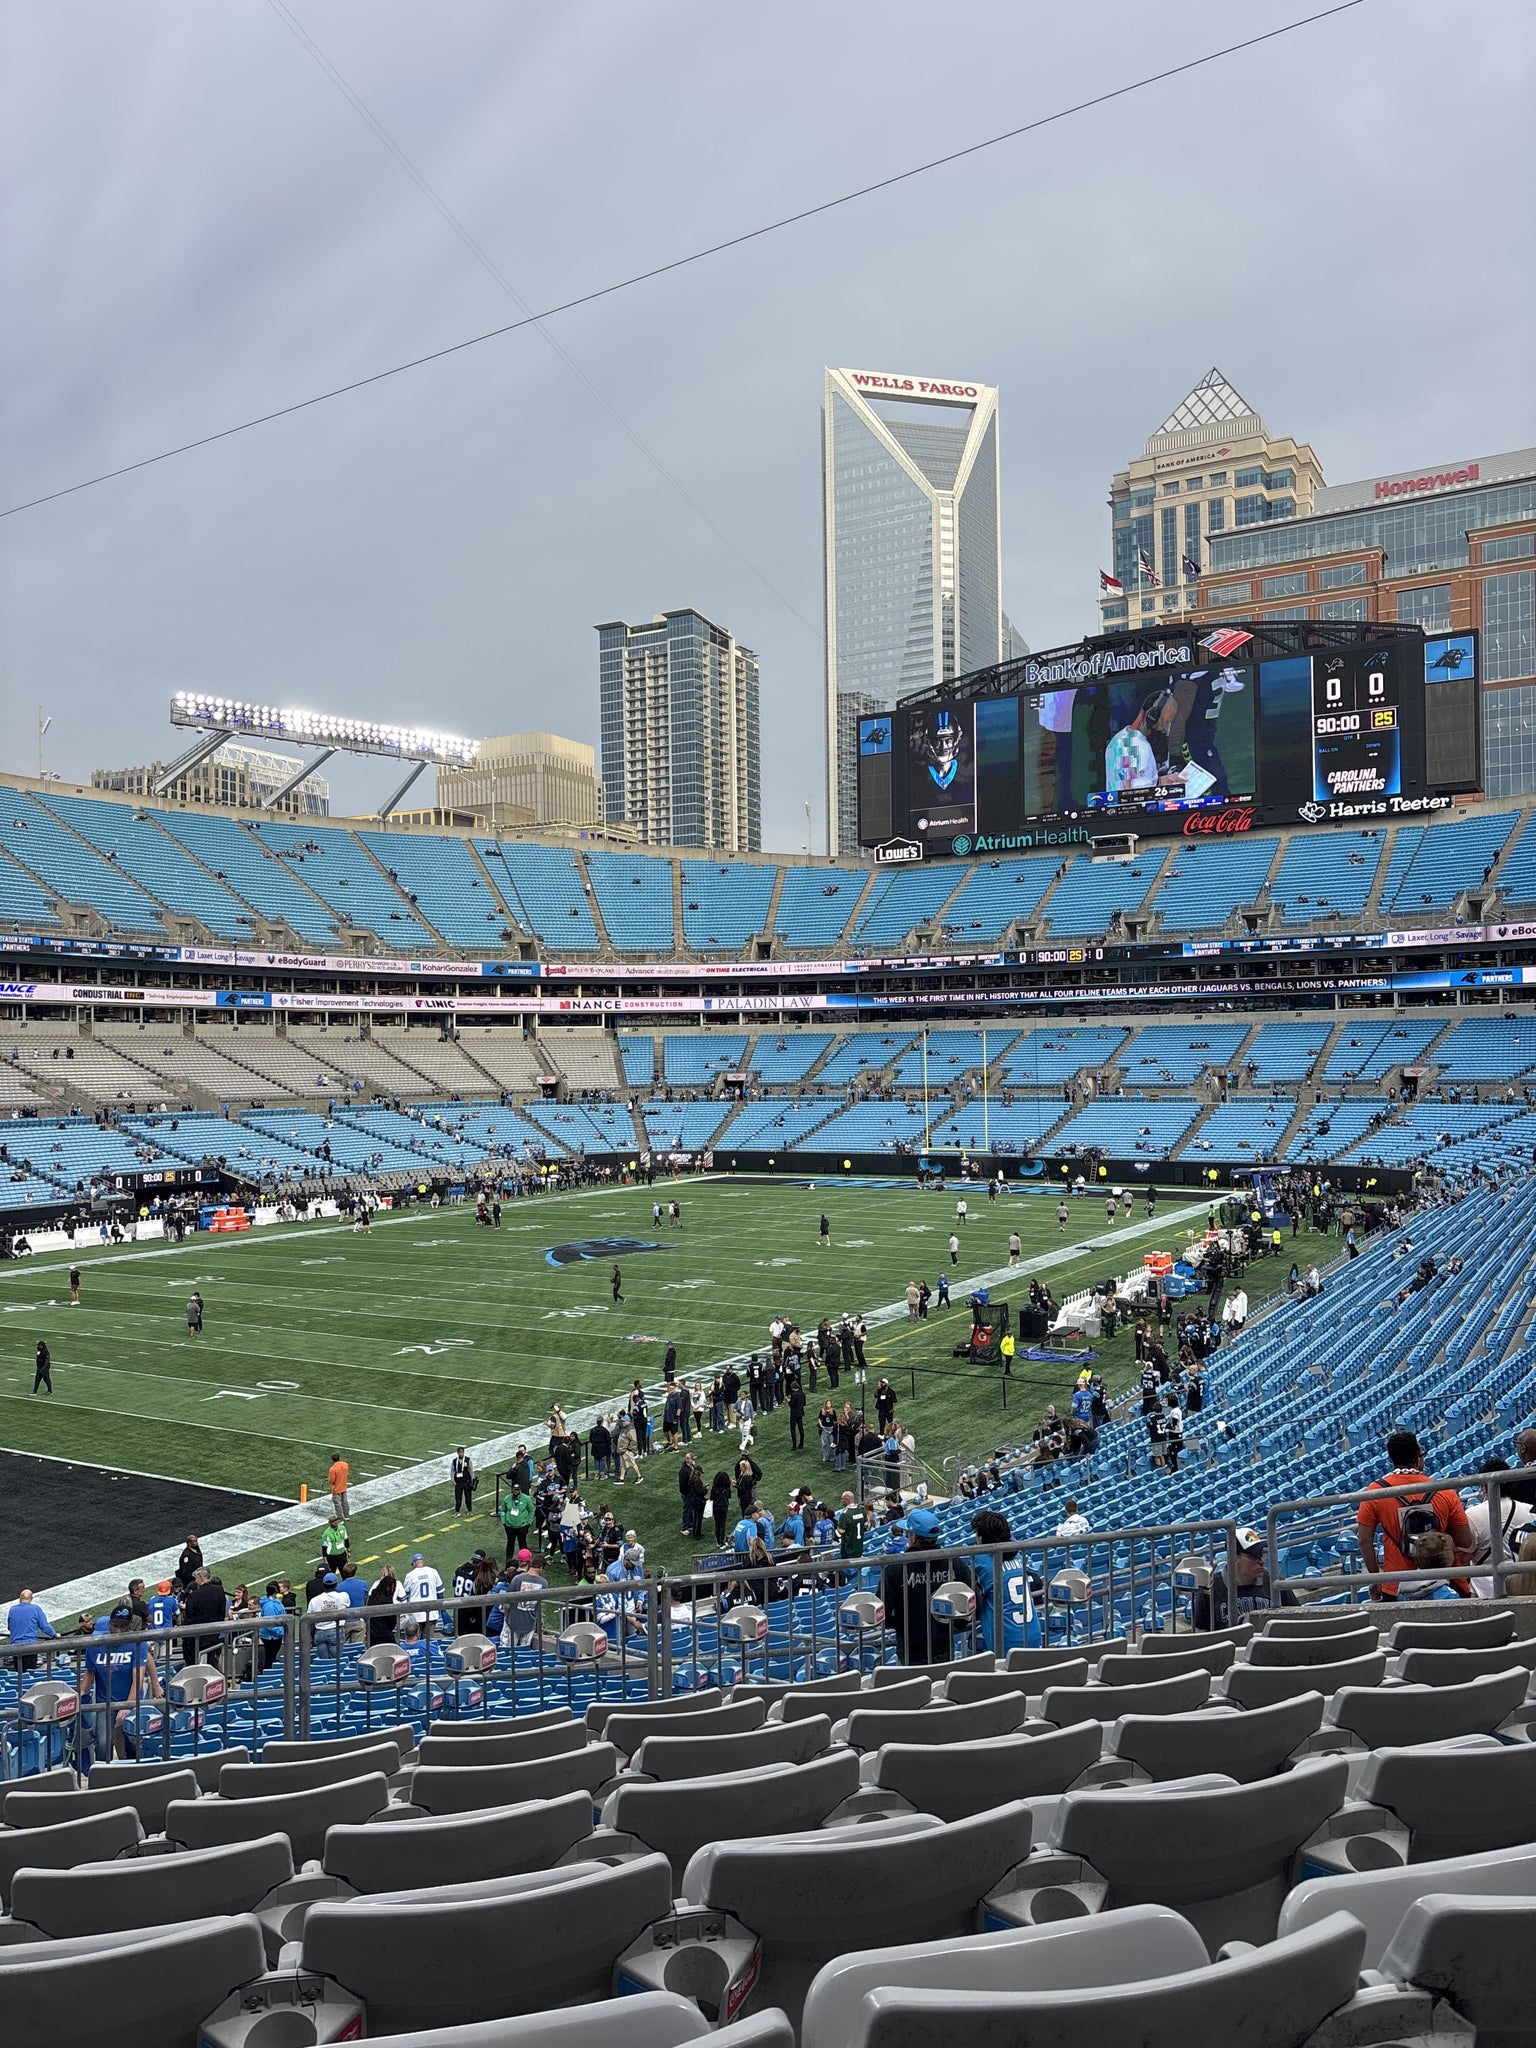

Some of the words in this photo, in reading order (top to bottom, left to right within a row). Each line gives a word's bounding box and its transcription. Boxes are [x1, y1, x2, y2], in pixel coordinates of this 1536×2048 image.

[852, 374, 914, 391] WELLS
[918, 381, 978, 398] FARGO
[1157, 461, 1175, 470] BANK
[1185, 453, 1216, 464] AMERICA
[1374, 463, 1480, 498] Honeywell
[1025, 657, 1077, 685] Bank
[1077, 653, 1101, 676] of
[1101, 644, 1191, 674] America
[1326, 678, 1341, 700] 0
[1369, 672, 1384, 695] 0
[1316, 714, 1360, 734] 90:00
[1374, 711, 1393, 727] 25
[1327, 767, 1377, 784] CAROLINA
[1154, 786, 1168, 797] 26
[1333, 778, 1386, 794] PANTHERS
[1107, 792, 1114, 801] 6
[1329, 800, 1387, 818] Harris
[1389, 796, 1450, 813] Teeter
[929, 819, 950, 827] Atrium
[950, 817, 969, 825] Health
[974, 832, 1033, 852] Atrium
[1035, 826, 1090, 845] Health
[878, 846, 918, 861] LOWE'S
[1429, 933, 1449, 942] Long
[1455, 931, 1483, 940] Savage
[3, 943, 31, 952] PANTHERS
[1194, 948, 1220, 956] PANTHERS
[214, 954, 229, 963] Long
[234, 954, 256, 964] Savage
[1019, 952, 1026, 963] 0
[1038, 951, 1066, 962] 90:00
[1069, 950, 1082, 961] 25
[1095, 948, 1103, 960] 0
[278, 956, 326, 967] eBodyGuard
[344, 959, 371, 970] PERRY'S
[422, 964, 478, 973] KohariGonzalez
[624, 967, 654, 975] Advance
[1481, 975, 1513, 983] PARTNERS
[1149, 986, 1170, 994] EACH
[1171, 985, 1198, 993] OTHER
[1199, 984, 1238, 992] (JAGUARS
[1239, 983, 1253, 991] VS.
[1254, 982, 1295, 991] BENGALS,
[1296, 981, 1321, 989] LIONS
[1323, 980, 1336, 988] VS.
[1338, 978, 1387, 988] PANTHERS)
[72, 988, 123, 1000] CONDUSTRIAL
[290, 995, 314, 1006] Fisher
[315, 996, 359, 1007] Improvement
[360, 998, 403, 1009] Technologies
[572, 1000, 622, 1009] NANCE
[718, 998, 778, 1009] PALADIN
[782, 997, 814, 1008] LAW
[142, 1173, 163, 1183] 90:00
[165, 1172, 175, 1182] 25
[195, 1170, 202, 1182] 0
[115, 1176, 122, 1189] 0
[542, 1304, 609, 1320] 30
[978, 1332, 987, 1342] G
[390, 1338, 475, 1356] 20
[753, 1370, 759, 1379] 9
[1142, 1380, 1154, 1389] 59
[198, 1380, 301, 1402] 10
[1081, 1401, 1090, 1412] 32
[856, 1522, 862, 1540] 1
[419, 1582, 429, 1598] 0
[454, 1576, 474, 1597] 89
[1007, 1576, 1033, 1625] 9
[153, 1610, 164, 1625] 0
